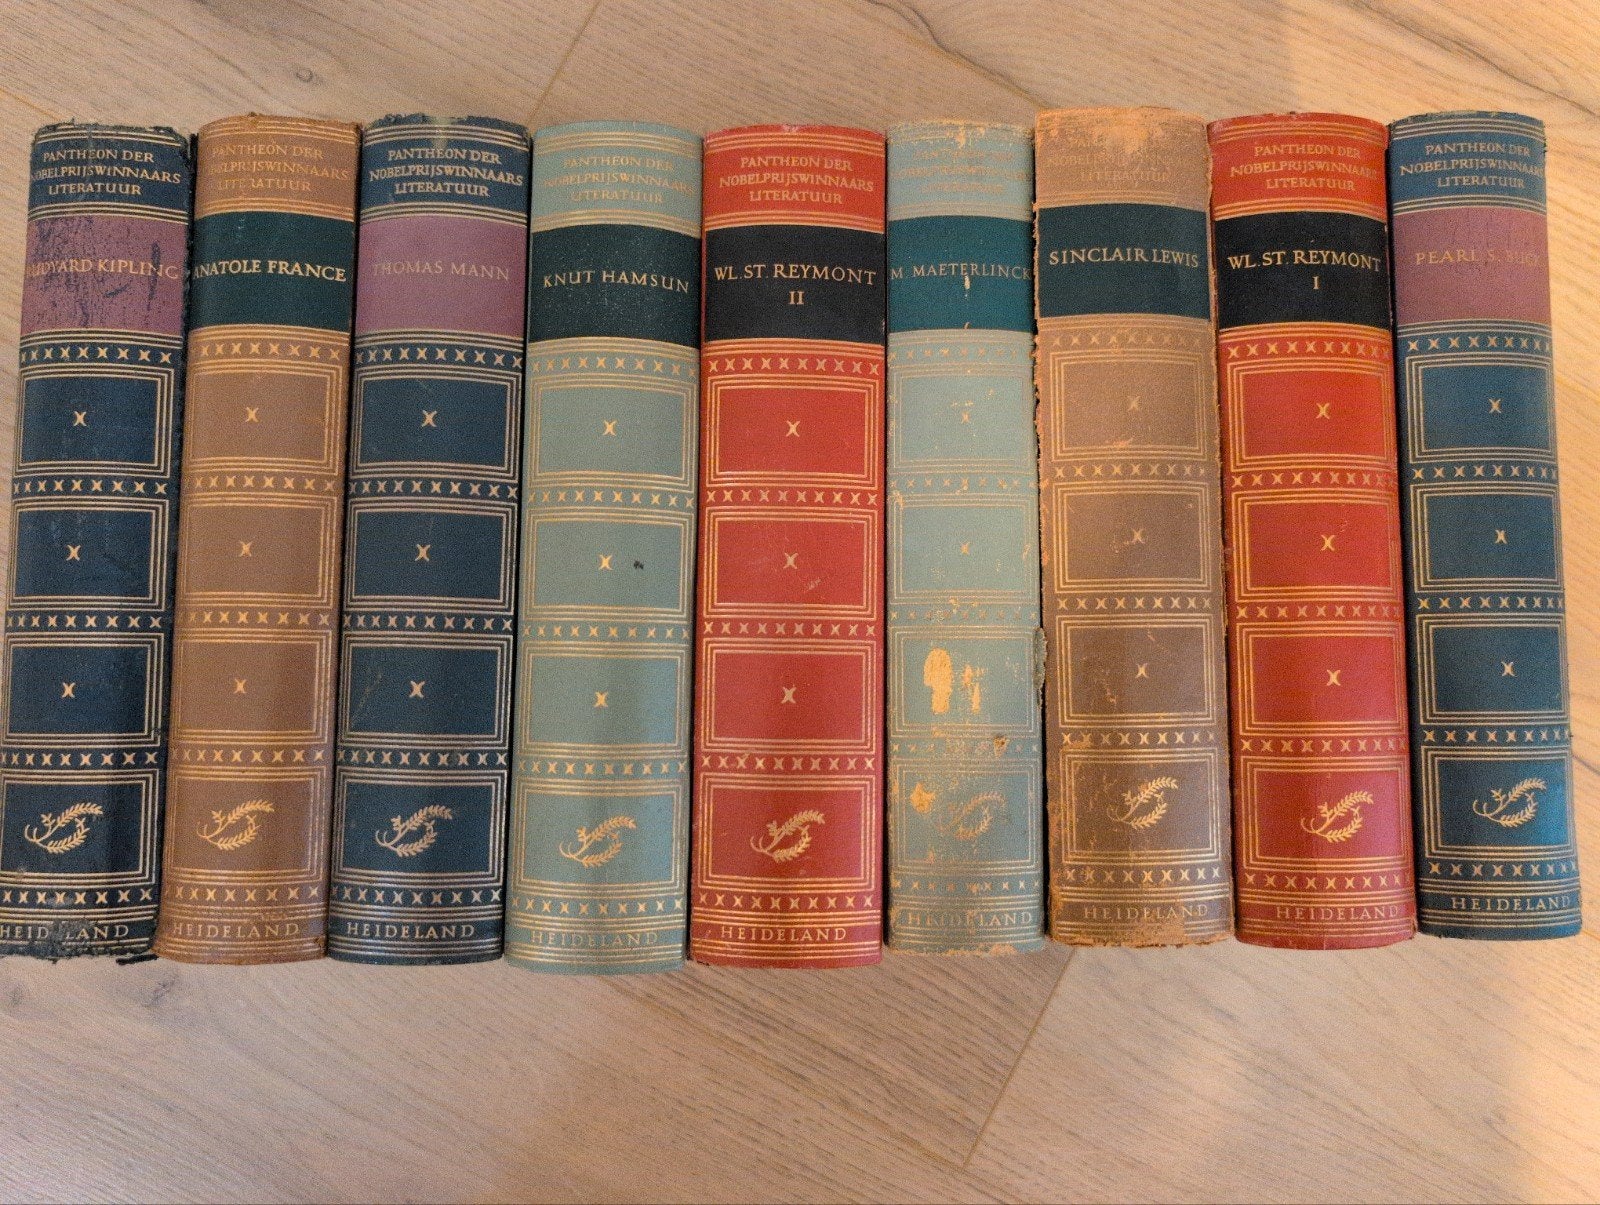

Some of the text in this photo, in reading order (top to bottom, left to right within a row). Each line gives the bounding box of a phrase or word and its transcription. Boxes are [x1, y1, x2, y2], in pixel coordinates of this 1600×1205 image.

[43, 148, 155, 164] PANTHEON DER
[212, 144, 324, 159] PANTHEON DER
[388, 146, 502, 165] PANTHEON DER
[1254, 143, 1361, 159] PANTHEON DER
[1425, 142, 1531, 157] PANTHEON DER
[203, 160, 350, 180] BELPRIJSWINNAARS
[563, 155, 674, 172] PANTHEON DER
[740, 156, 853, 172] PANTHEON DER
[369, 164, 524, 187] NOBELPRIJSWINNAARS
[719, 172, 875, 192] NOBELPRIJSWINNAARS
[1437, 175, 1525, 189] LITERATUUR
[48, 181, 142, 195] LITERATUUR
[394, 181, 490, 197] LITERATUUR
[1266, 177, 1355, 191] LITERATUUR
[571, 189, 663, 204] LITERATUUR
[749, 190, 843, 205] LITERATUUR
[1049, 248, 1199, 268] SINCLAIR LEWIS
[1293, 250, 1381, 272] REYMONT
[1416, 248, 1479, 265] PEARL
[97, 258, 180, 280] KIPLING
[193, 258, 347, 283] ANATOLE FRANCE
[373, 260, 510, 281] THOMAS MANN
[774, 264, 876, 286] REYMONT
[913, 263, 1032, 281] MAETERLINCK
[543, 270, 690, 294] KNUT HAMSUN
[1311, 276, 1320, 290] I
[788, 291, 804, 306] II
[1451, 896, 1571, 911] HEIDELAND
[1084, 904, 1209, 920] HEIDELAND
[1276, 906, 1398, 920] HEIDELAND
[0, 924, 130, 939] HEIDLAND
[172, 922, 300, 938] HEIDELAND
[346, 922, 476, 939] HEIDELAND
[720, 926, 847, 941] HEIDELAND
[530, 930, 658, 948] HEIDELAND
